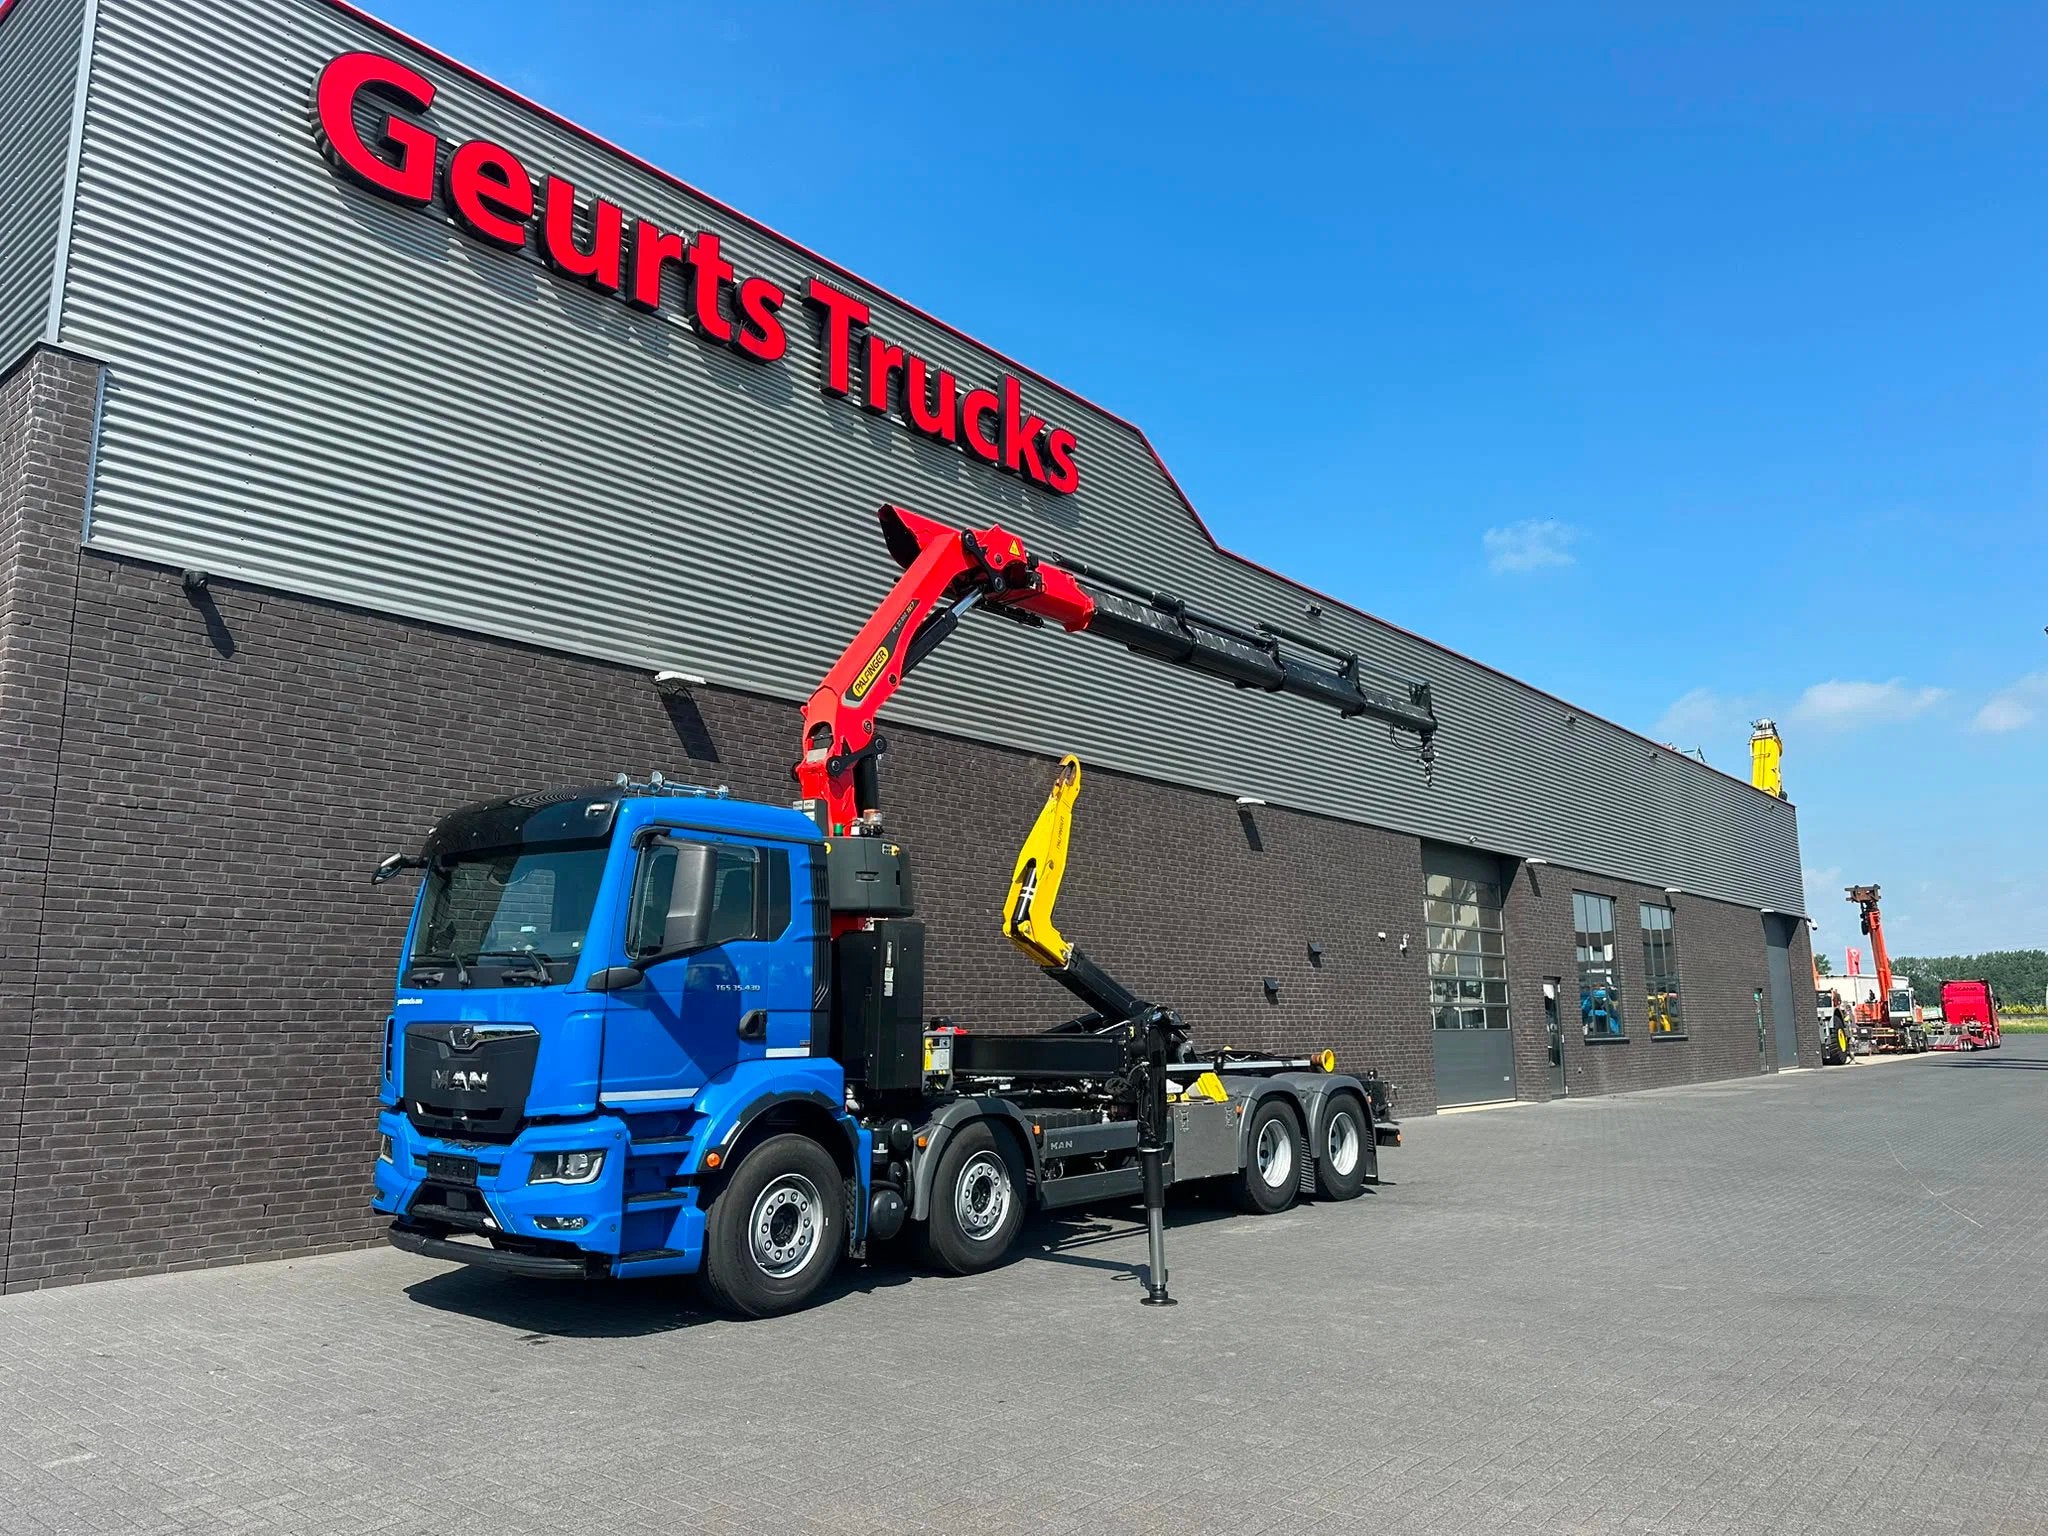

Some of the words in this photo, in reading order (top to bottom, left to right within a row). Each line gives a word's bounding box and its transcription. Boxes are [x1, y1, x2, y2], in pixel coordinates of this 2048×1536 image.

[312, 50, 788, 362] Geurts
[806, 276, 1081, 494] Trucks
[855, 650, 887, 693] PALFINGER
[431, 1069, 489, 1093] MAN
[1050, 1140, 1073, 1150] MAN
